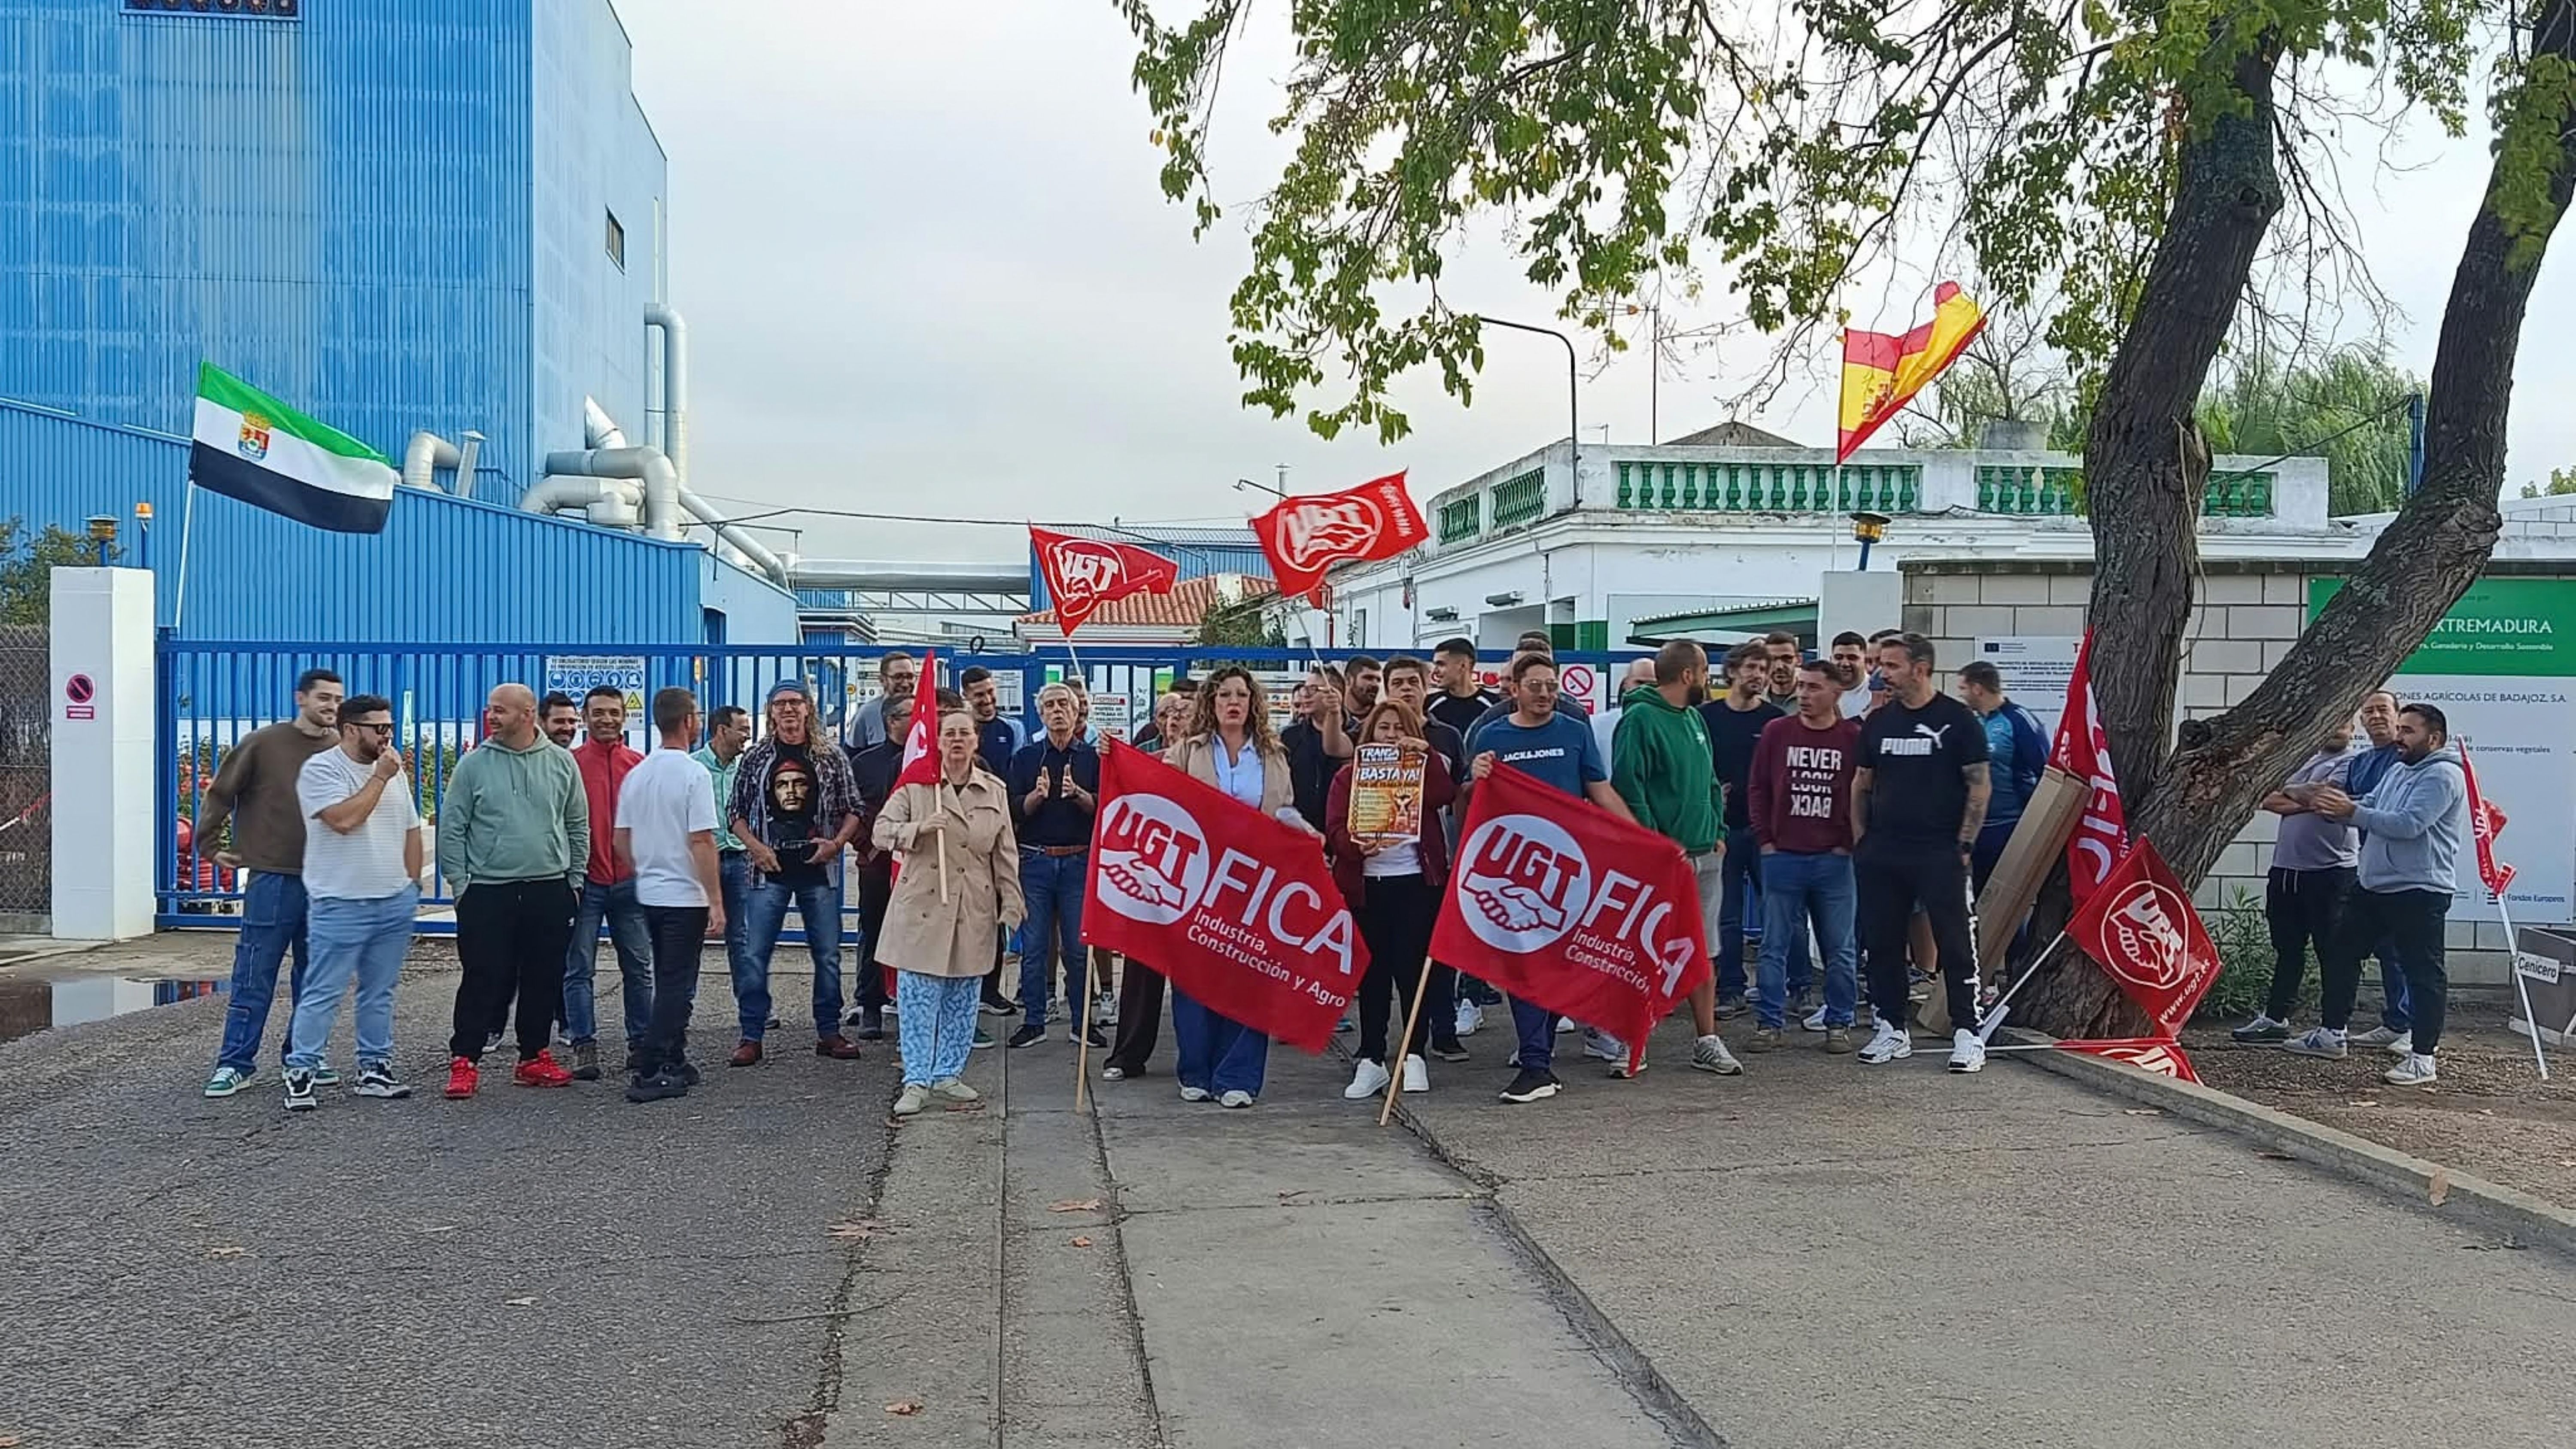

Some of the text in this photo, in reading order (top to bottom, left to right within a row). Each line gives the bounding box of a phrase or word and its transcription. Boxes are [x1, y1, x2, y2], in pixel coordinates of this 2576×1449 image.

[1053, 546, 1118, 596] UGT
[2432, 619, 2552, 633] XTREMADURA
[2424, 691, 2480, 702] AGRÍCOLAS
[2484, 693, 2496, 702] DE
[1880, 738, 1932, 755] PUMA
[2516, 745, 2550, 753] vegetales
[1786, 746, 1841, 771] NEVER
[1403, 768, 1420, 781] YA!
[1102, 802, 1200, 885] UGT
[1473, 824, 1582, 909] UGT
[2533, 894, 2565, 902] Europeos
[1202, 848, 1355, 975] FICA
[1194, 908, 1269, 955] Industria,
[1188, 925, 1346, 1007] Construcción y Agro
[2518, 957, 2556, 978] Cenicero
